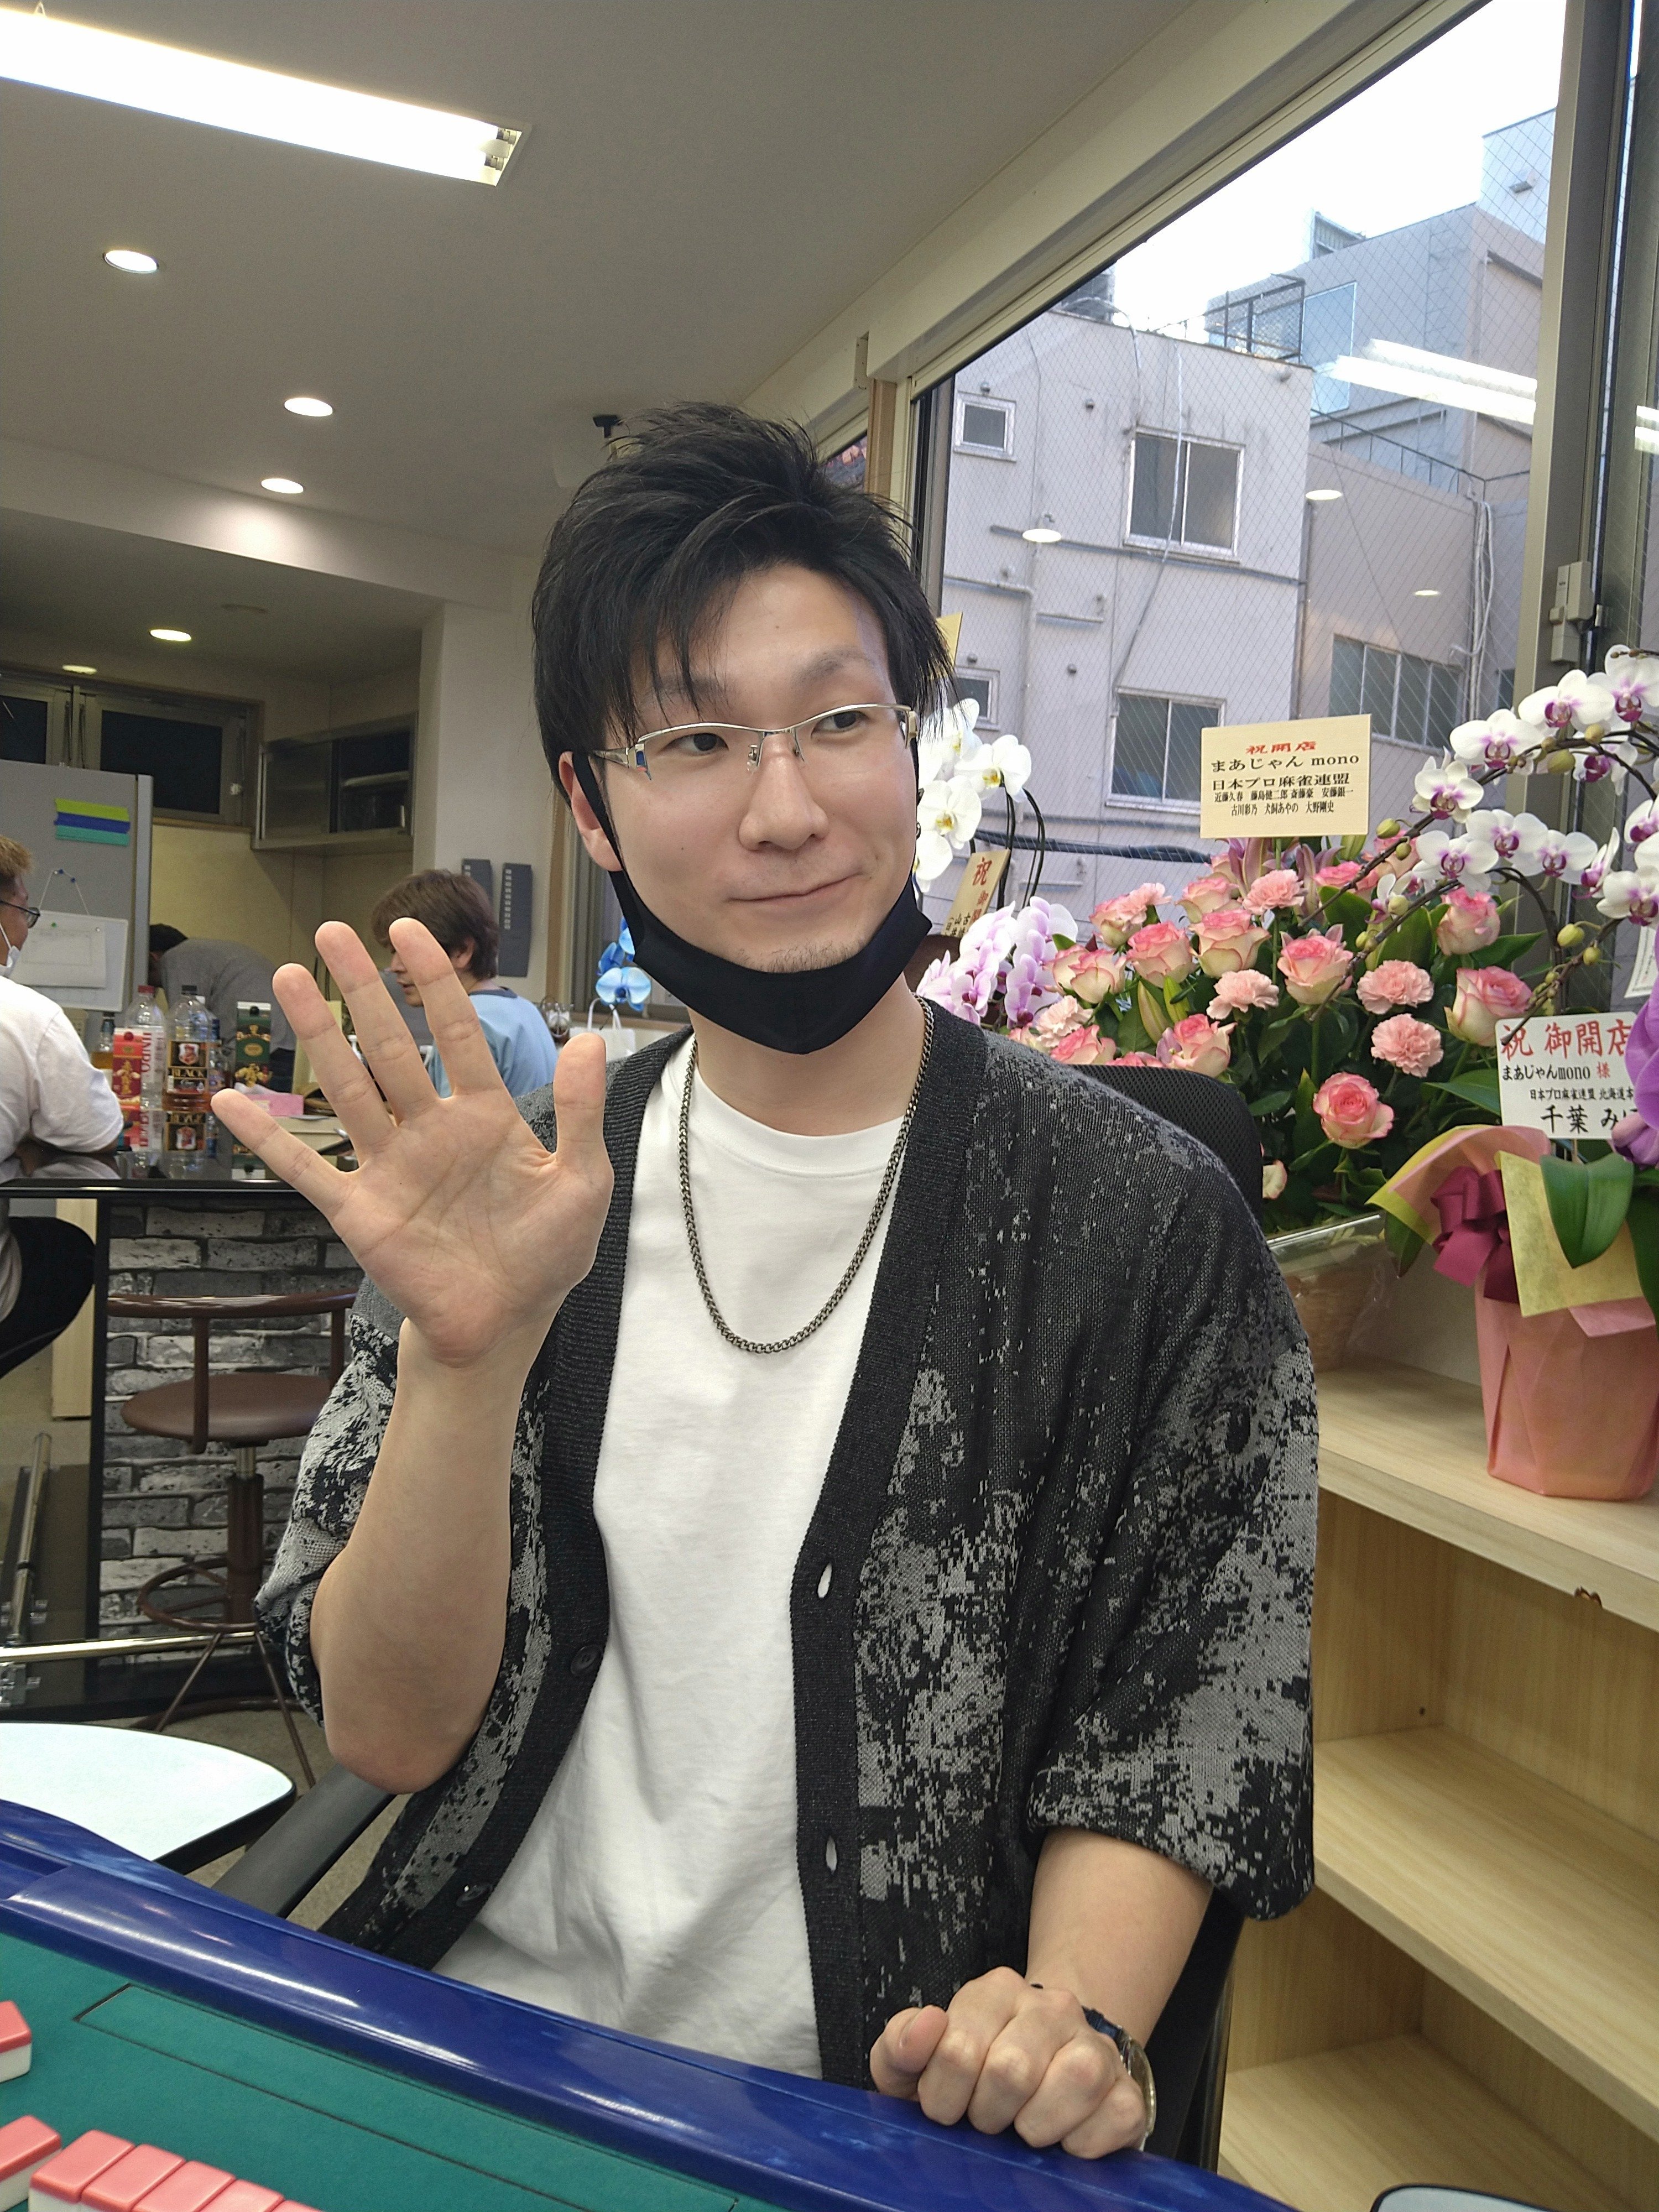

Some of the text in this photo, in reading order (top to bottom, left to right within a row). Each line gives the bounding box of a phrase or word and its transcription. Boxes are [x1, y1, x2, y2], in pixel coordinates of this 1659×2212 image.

[1245, 741, 1316, 754] 祝開店
[1211, 755, 1359, 772] まあじゃん mono
[1213, 773, 1349, 790] 日本プロ麻雀連盟
[1501, 1019, 1632, 1061] 祝 御開店
[1502, 1062, 1610, 1081] まあじゃんmono 様
[1530, 1087, 1596, 1102] 日本プロ麻雀連盟
[1540, 1104, 1588, 1134] 千葉
